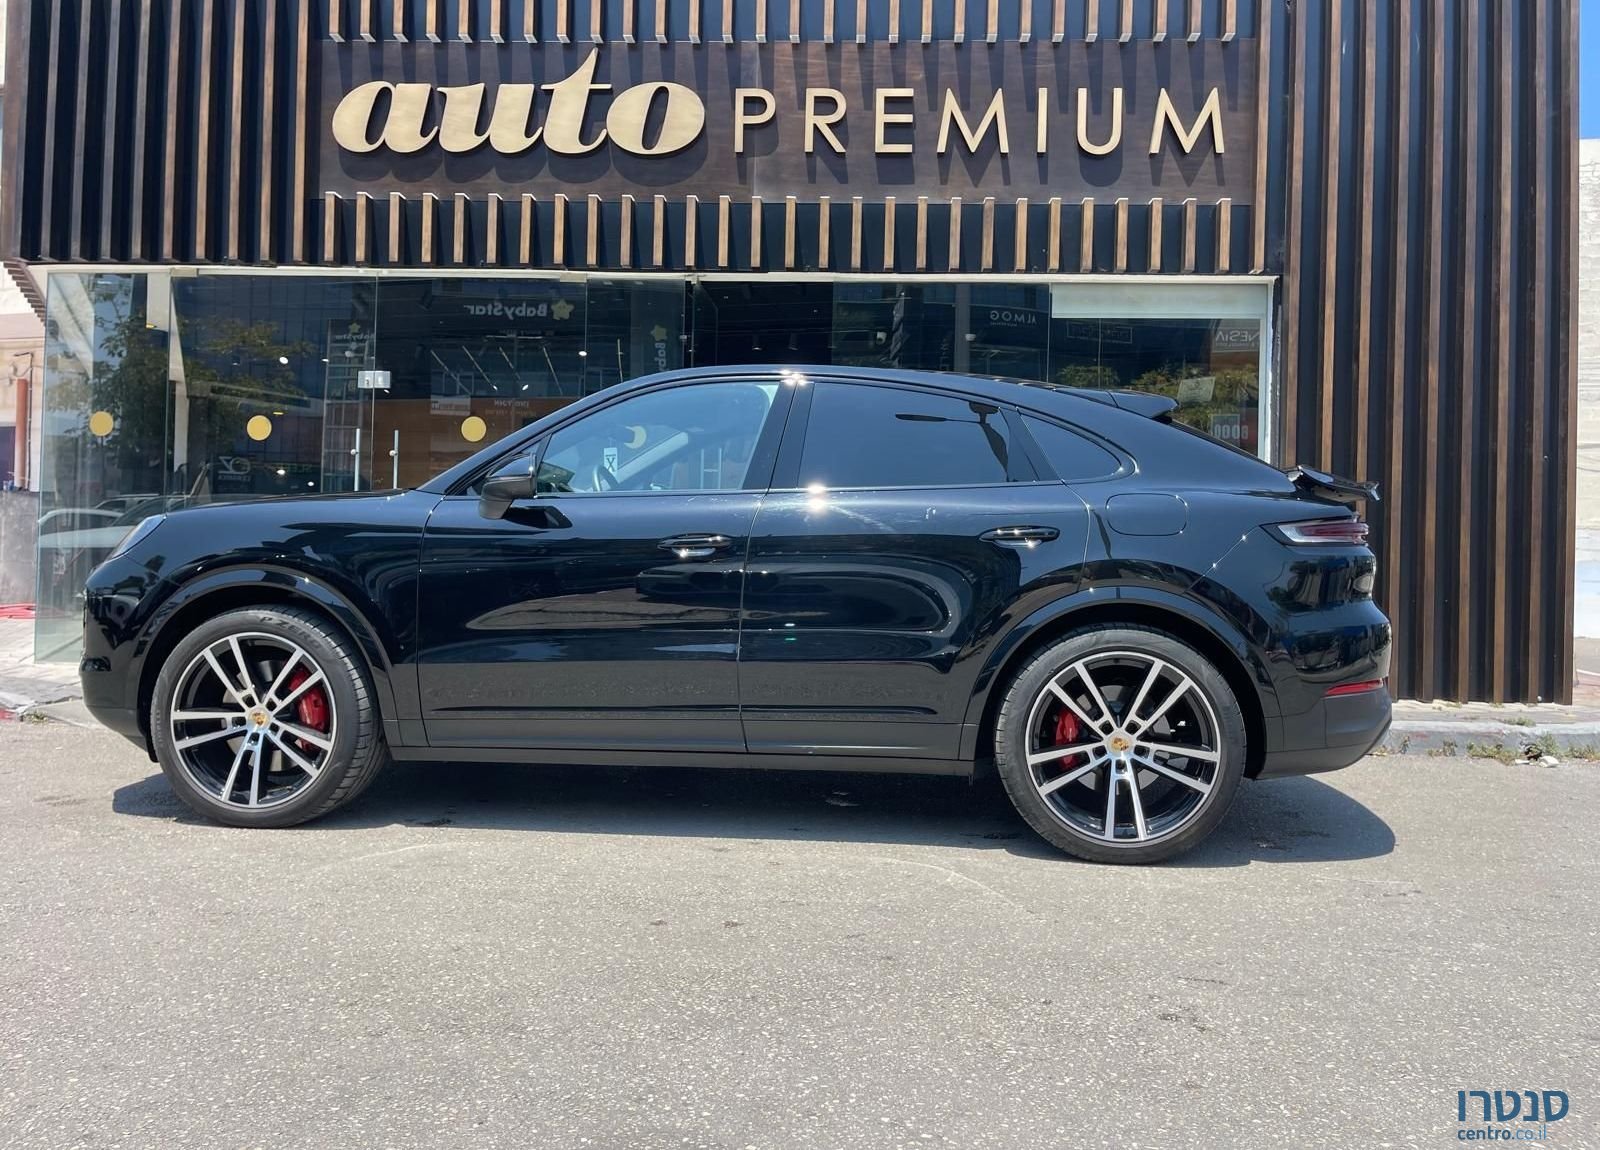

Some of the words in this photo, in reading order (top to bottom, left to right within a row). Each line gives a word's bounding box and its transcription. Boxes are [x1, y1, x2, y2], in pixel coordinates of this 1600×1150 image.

[331, 47, 706, 156] auto
[734, 87, 1225, 155] PREMIUM
[276, 620, 322, 648] ZERO
